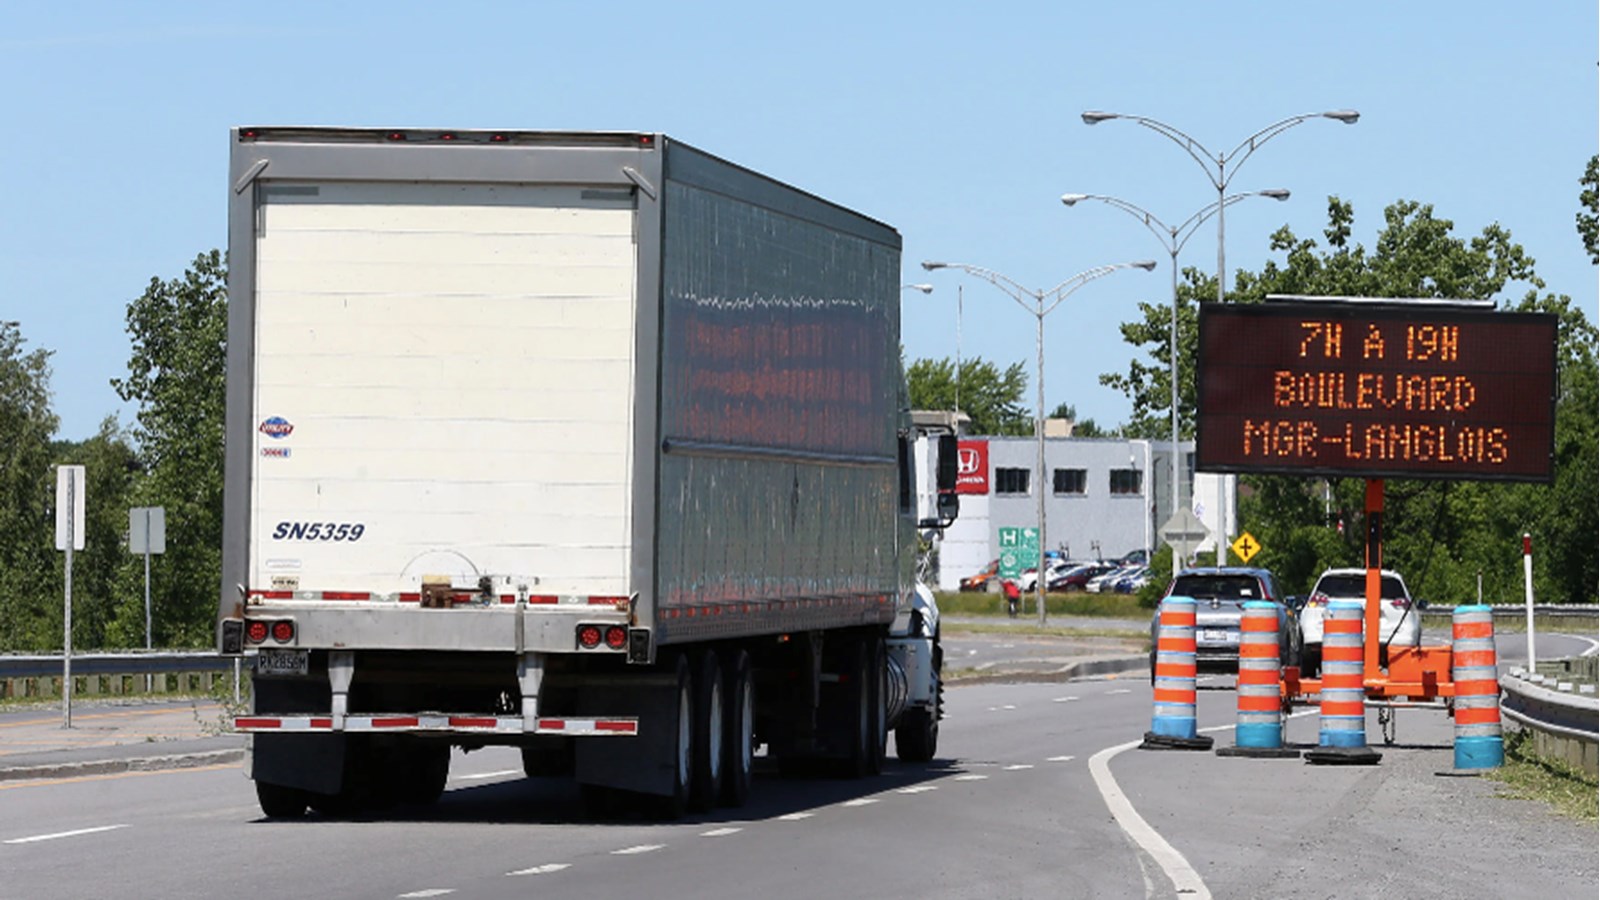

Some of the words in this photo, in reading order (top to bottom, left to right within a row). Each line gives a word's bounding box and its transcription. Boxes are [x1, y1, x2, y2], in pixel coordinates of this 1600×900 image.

[1301, 322, 1342, 358] 7H
[1363, 324, 1385, 359] A
[1407, 325, 1459, 361] 19H
[1274, 370, 1476, 411] BOULEVARD
[1243, 420, 1508, 463] MGR-LANGLOIS
[272, 522, 365, 541] SN5359
[1003, 529, 1017, 547] H
